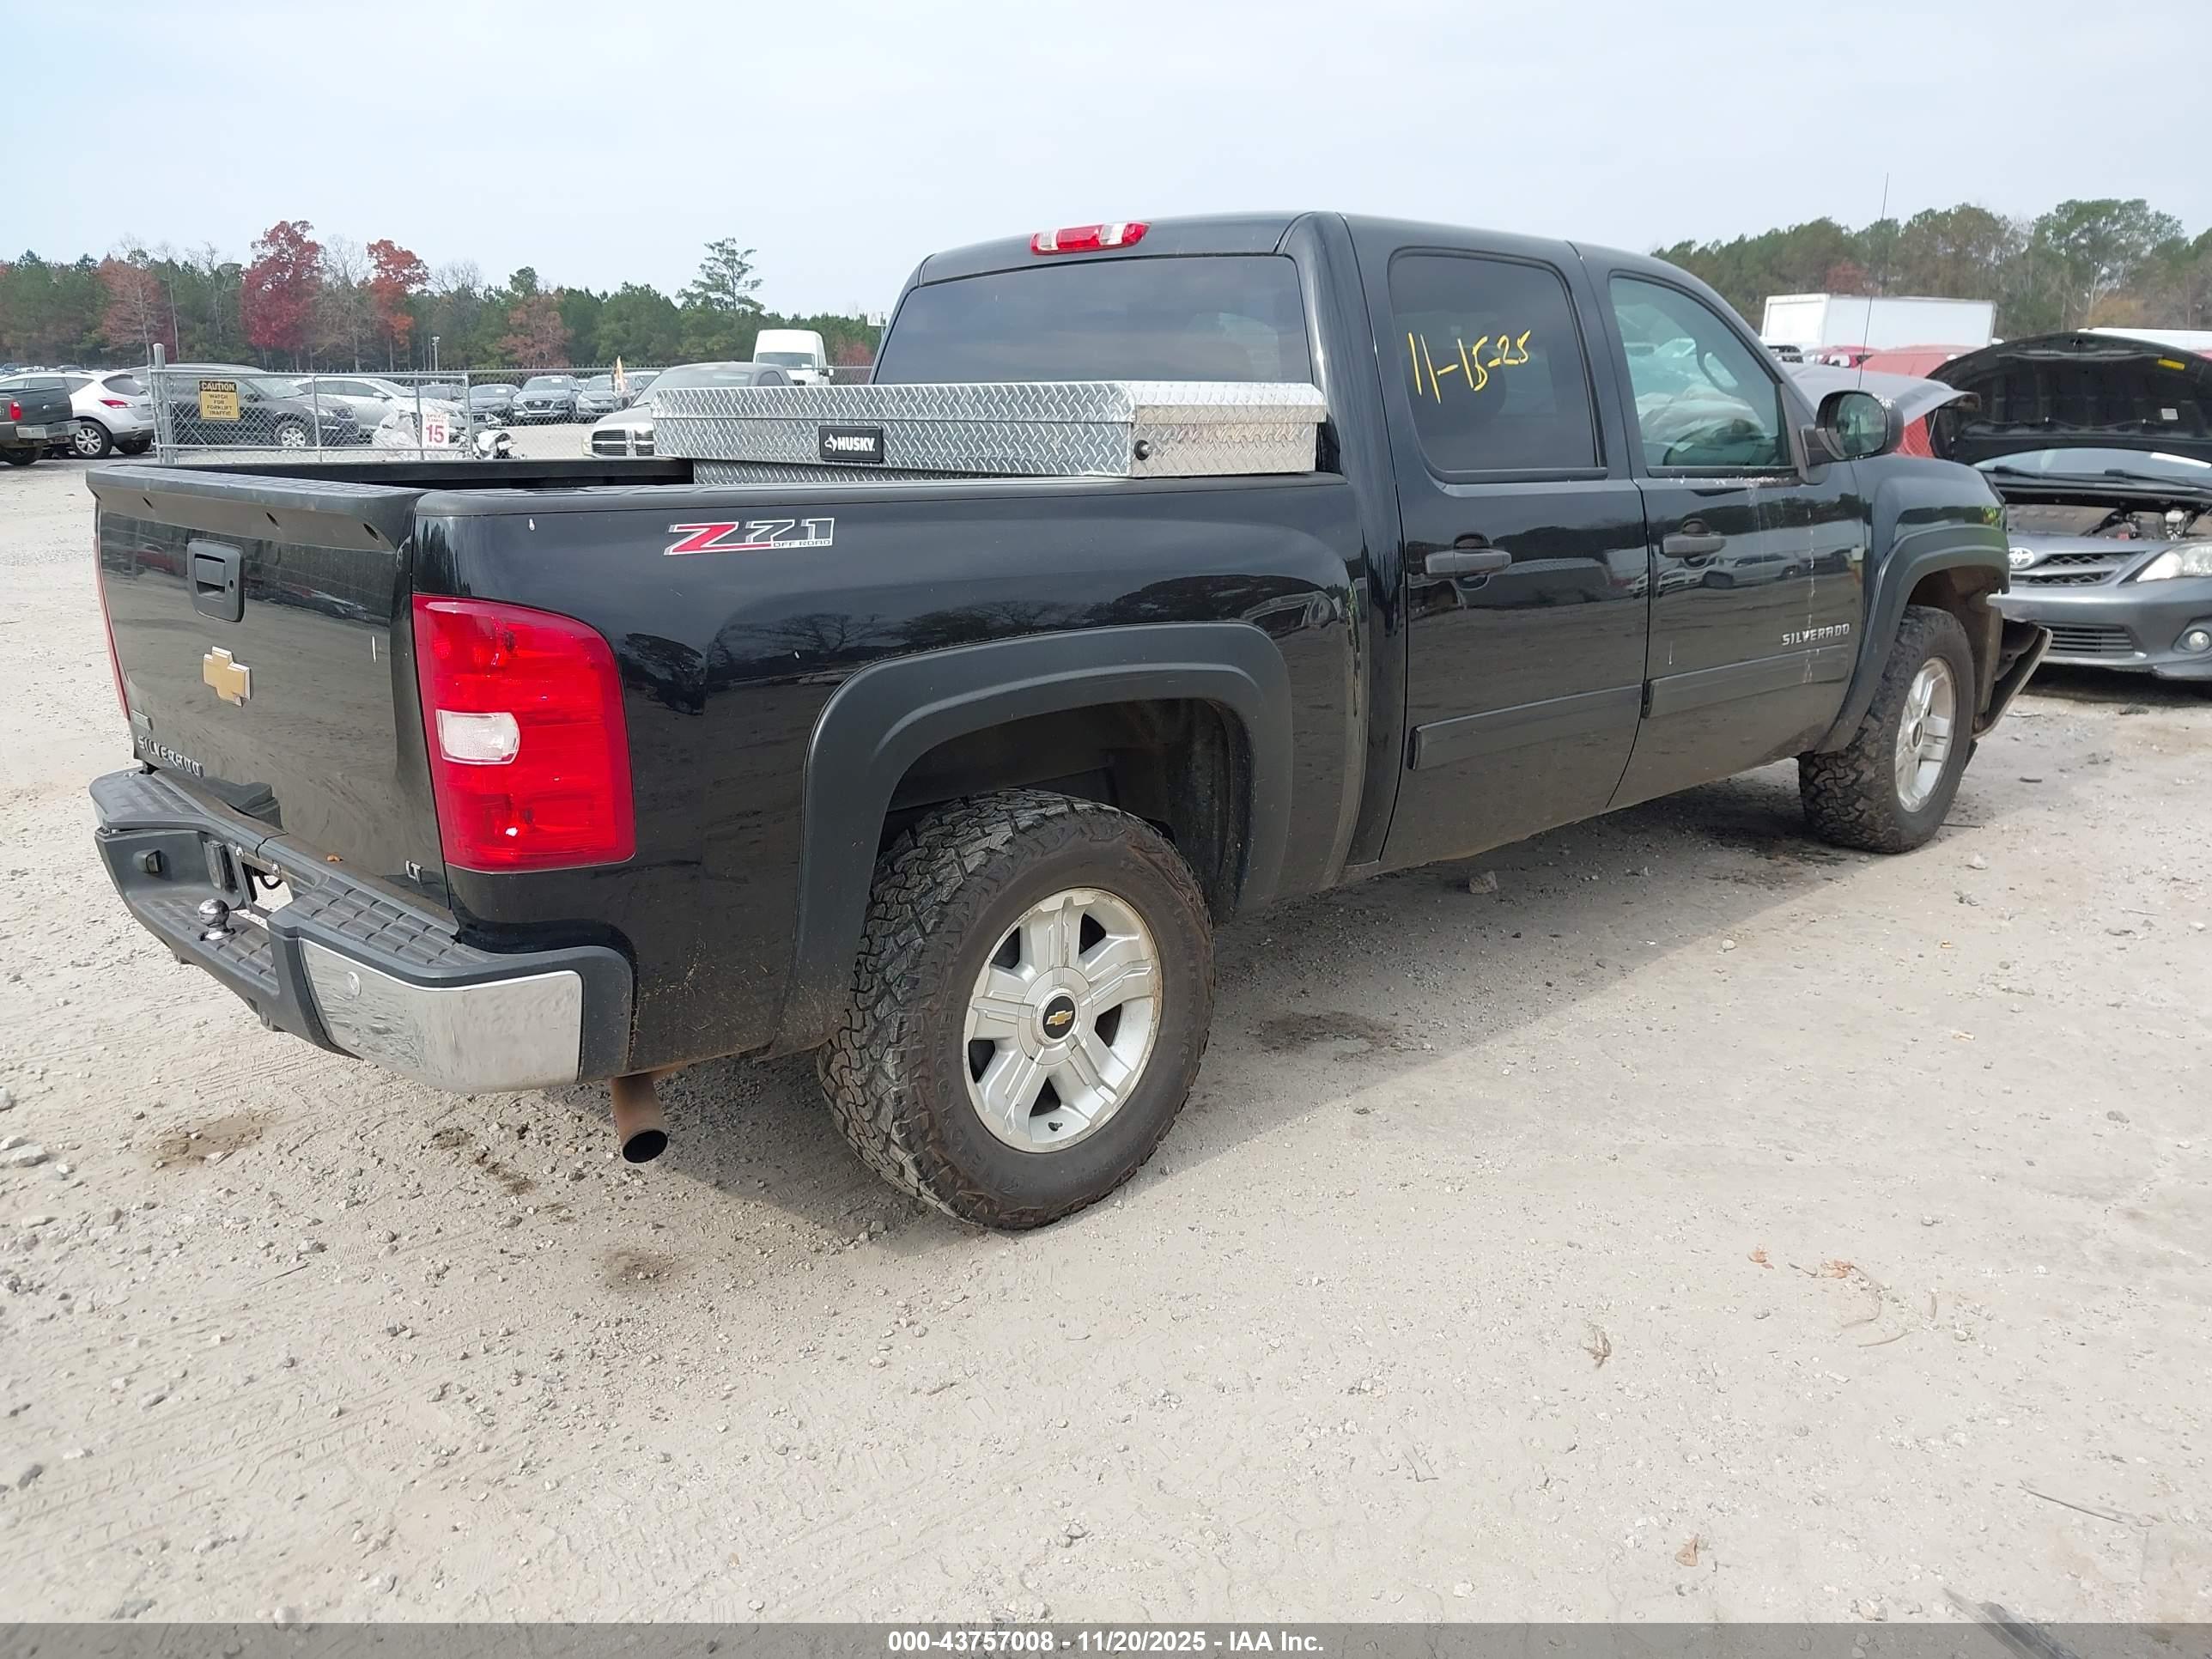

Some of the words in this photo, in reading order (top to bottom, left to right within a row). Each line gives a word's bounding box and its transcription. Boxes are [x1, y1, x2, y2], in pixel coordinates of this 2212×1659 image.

[201, 382, 234, 391] CAUTION
[426, 424, 444, 443] 15
[837, 436, 874, 452] HUSKY
[663, 517, 836, 556] Z71
[1782, 622, 1850, 647] SILVERADO
[137, 735, 204, 778] SILVERADO
[405, 860, 421, 884] LT
